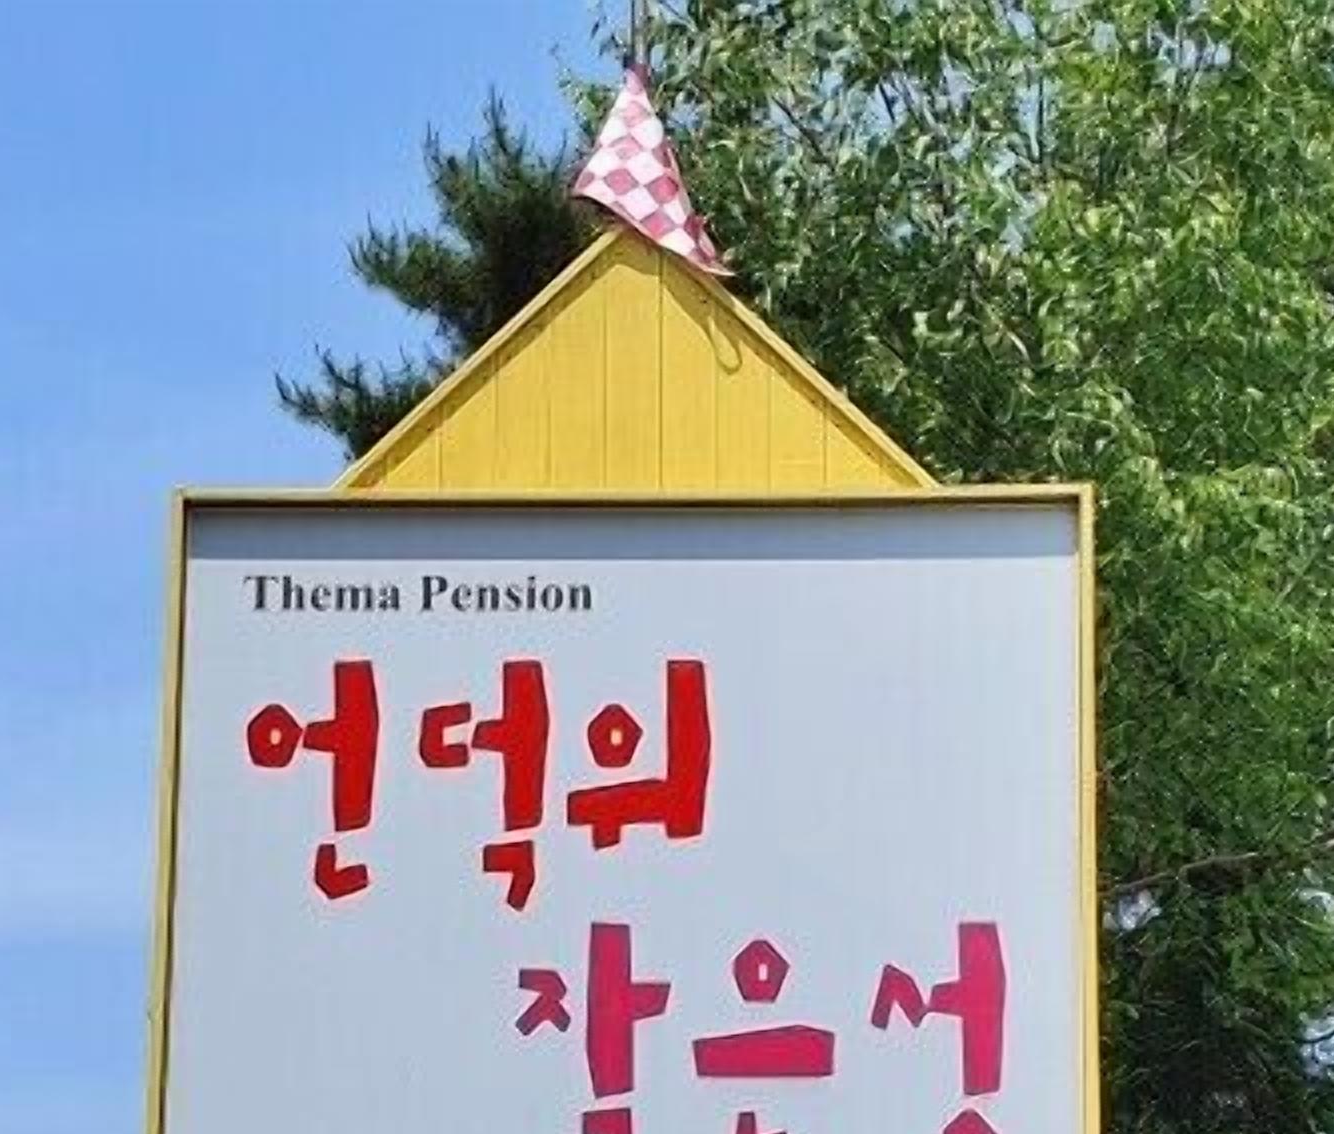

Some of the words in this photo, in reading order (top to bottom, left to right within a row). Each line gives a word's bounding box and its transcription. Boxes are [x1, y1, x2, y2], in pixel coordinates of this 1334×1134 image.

[243, 574, 400, 612] Thema
[420, 574, 593, 612] Pension
[246, 660, 711, 910] 언덕위
